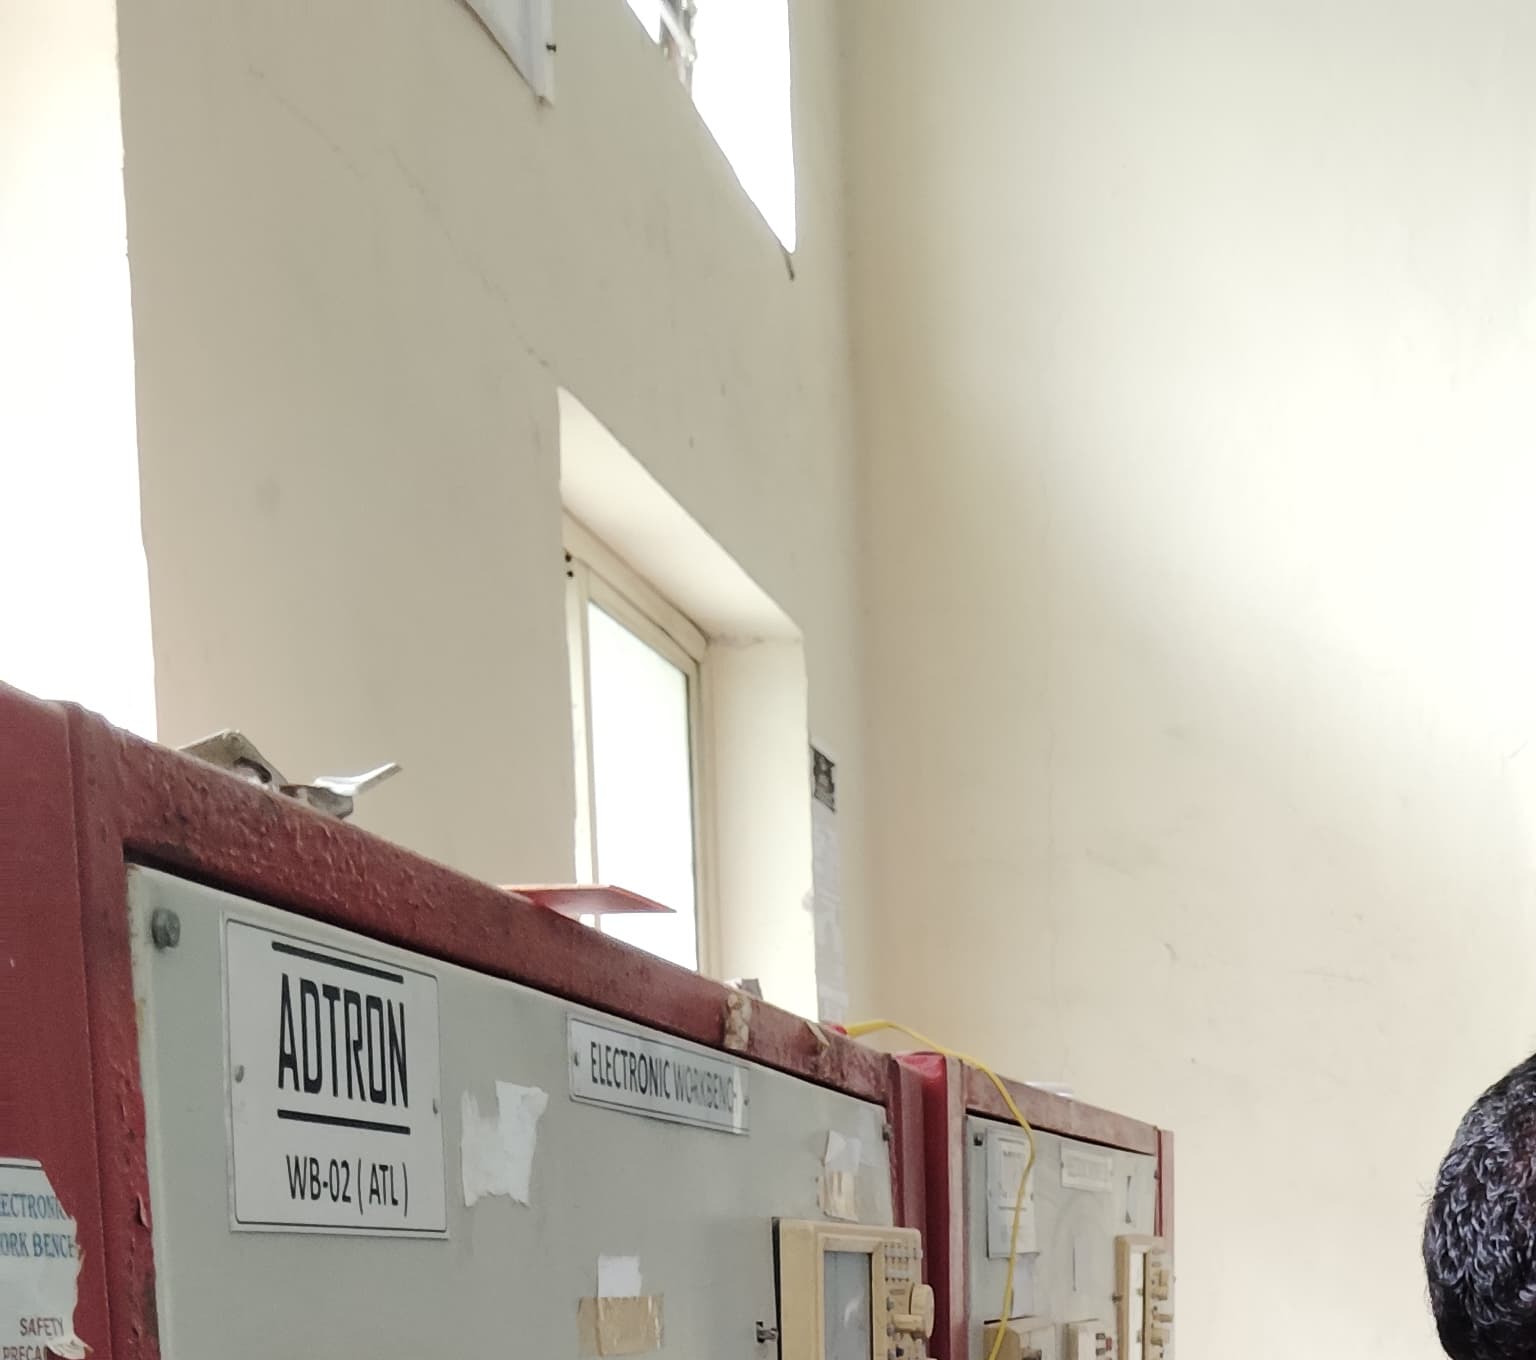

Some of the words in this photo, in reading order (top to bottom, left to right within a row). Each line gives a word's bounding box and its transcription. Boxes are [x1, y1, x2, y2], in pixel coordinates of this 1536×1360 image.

[277, 972, 409, 1109] ADTRON
[590, 1041, 670, 1099] ELECTRONIC
[286, 1154, 352, 1203] WB-02
[19, 1317, 65, 1337] SAFETY
